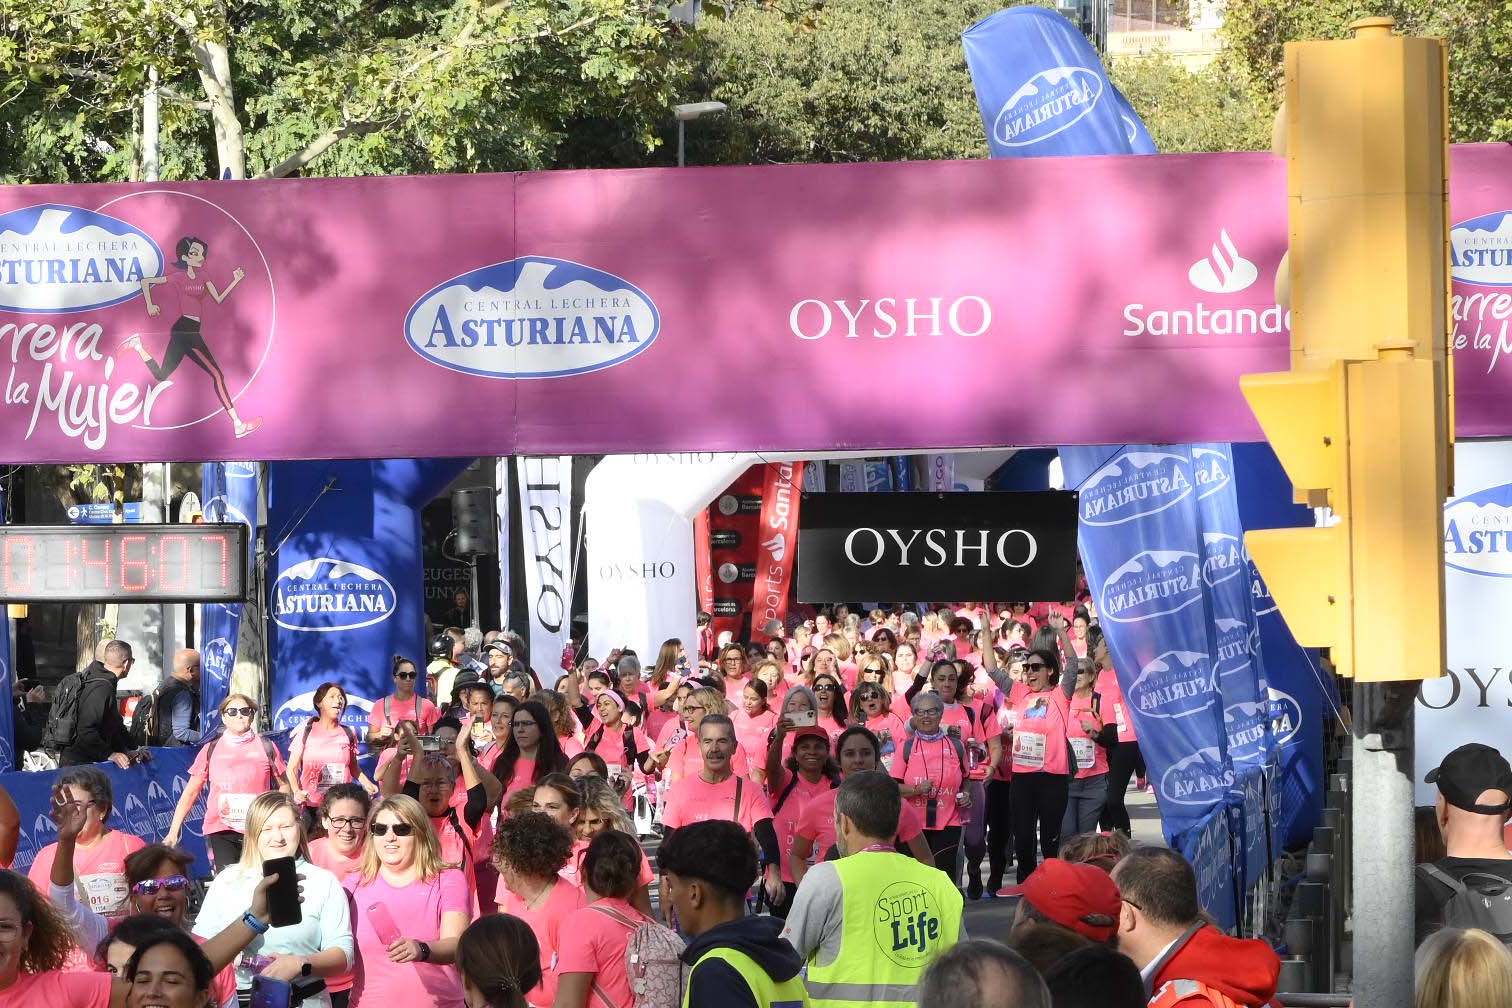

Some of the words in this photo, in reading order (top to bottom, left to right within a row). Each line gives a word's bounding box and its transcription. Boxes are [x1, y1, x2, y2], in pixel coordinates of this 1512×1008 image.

[464, 299, 543, 312] CENTRAL
[550, 297, 632, 311] LECHERA
[789, 296, 992, 341] OYSHO
[1123, 302, 1291, 338] Santand
[424, 304, 640, 348] ASTURIANA
[5, 366, 29, 405] la
[25, 357, 174, 450] Mujer
[844, 527, 1038, 569] OYSHO
[287, 582, 329, 593] CENTRAL
[334, 582, 383, 592] LECHERA
[599, 561, 675, 581] OYSHO
[275, 589, 388, 615] ASTURIANA
[91, 896, 109, 904] 016
[879, 890, 928, 922] Sport
[891, 912, 938, 952] Life
